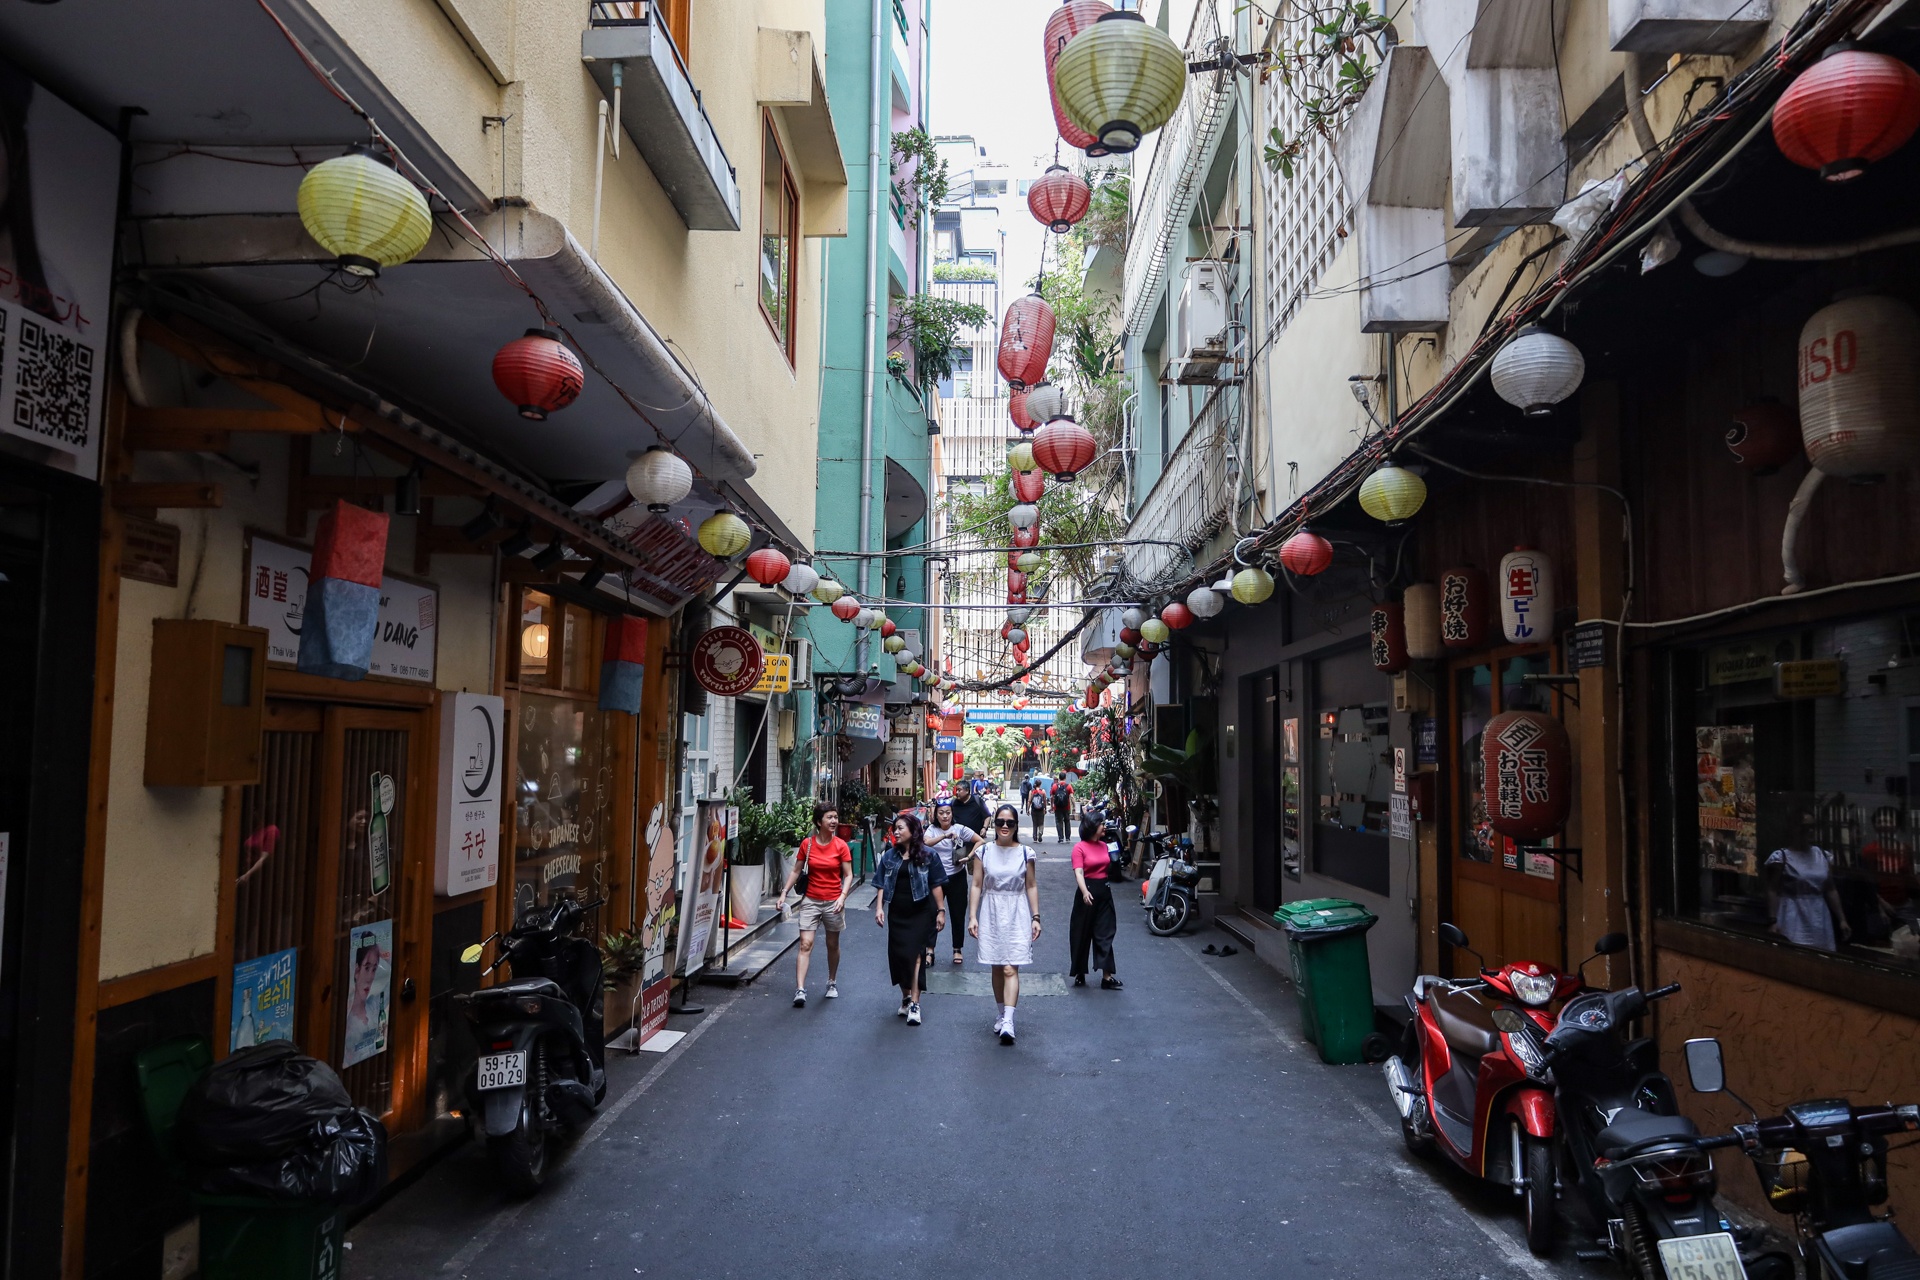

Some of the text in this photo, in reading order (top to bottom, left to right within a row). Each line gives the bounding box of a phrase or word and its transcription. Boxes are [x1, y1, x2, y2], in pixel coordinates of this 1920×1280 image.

[255, 565, 288, 603] 酒堂
[1508, 568, 1534, 639] 生ビール
[383, 620, 419, 651] DANG
[846, 719, 879, 730] MOON
[848, 710, 879, 722] TOKYO
[461, 828, 487, 861] 주당
[548, 823, 580, 848] JAPANESE
[543, 855, 581, 885] CHEESECAKE
[485, 1054, 519, 1072] 59-F2
[480, 1068, 523, 1088] 090.29
